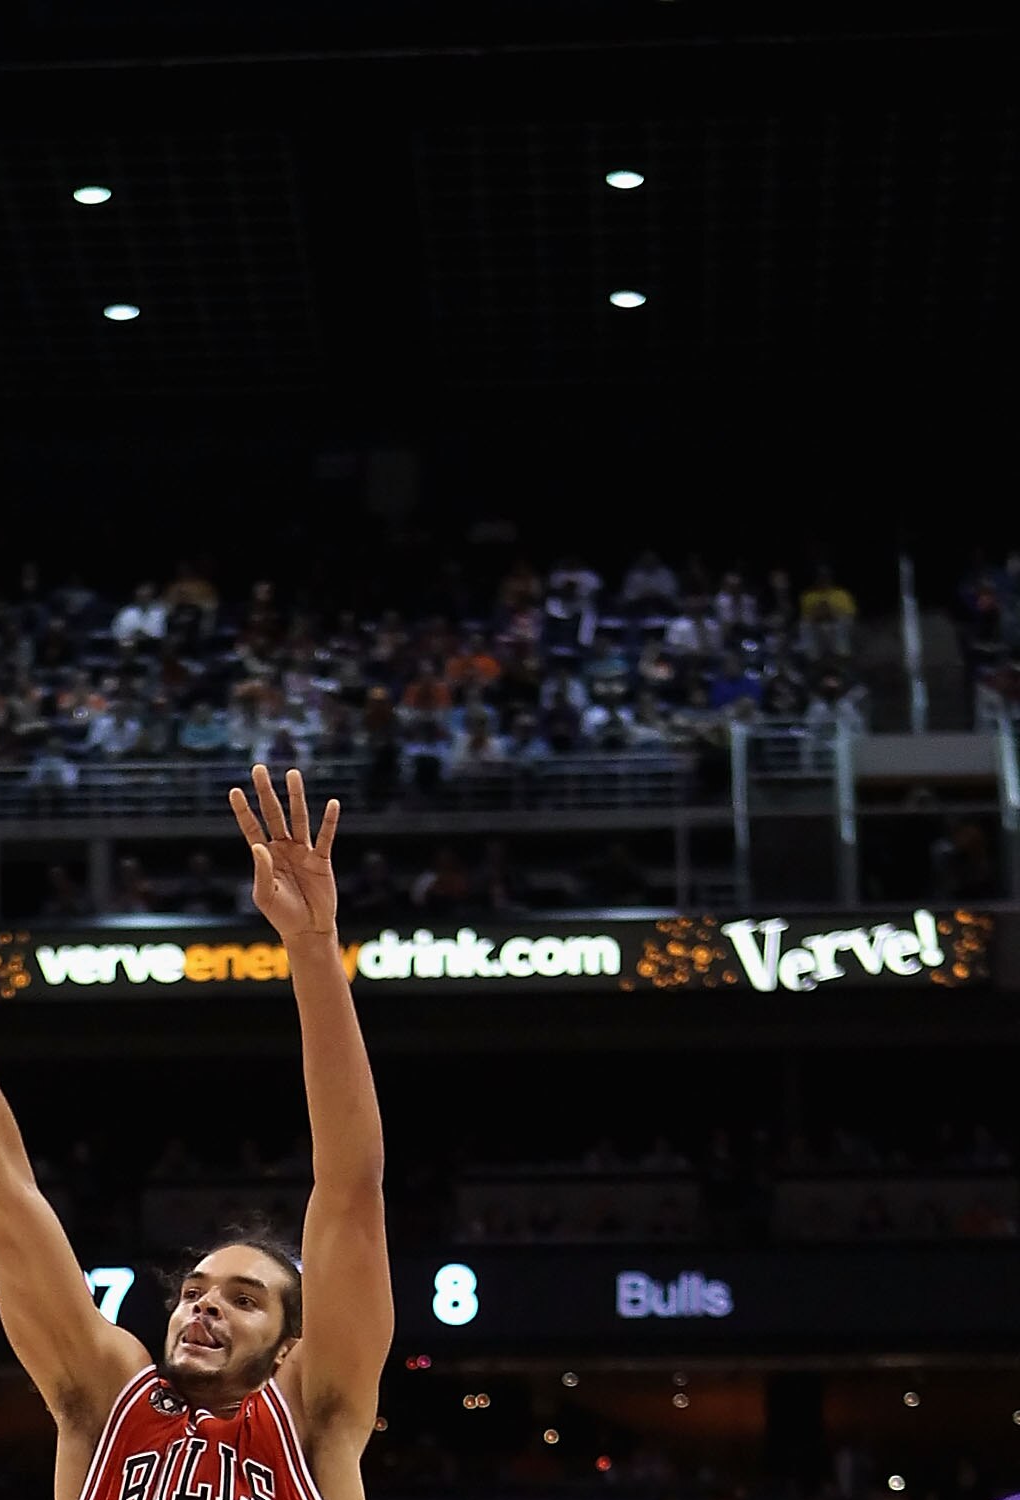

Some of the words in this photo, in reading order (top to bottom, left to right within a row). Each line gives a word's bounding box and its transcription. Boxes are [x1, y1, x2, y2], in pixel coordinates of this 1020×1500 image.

[721, 909, 944, 992] Verve!
[432, 1263, 479, 1325] 8
[615, 1269, 734, 1319] Bulls
